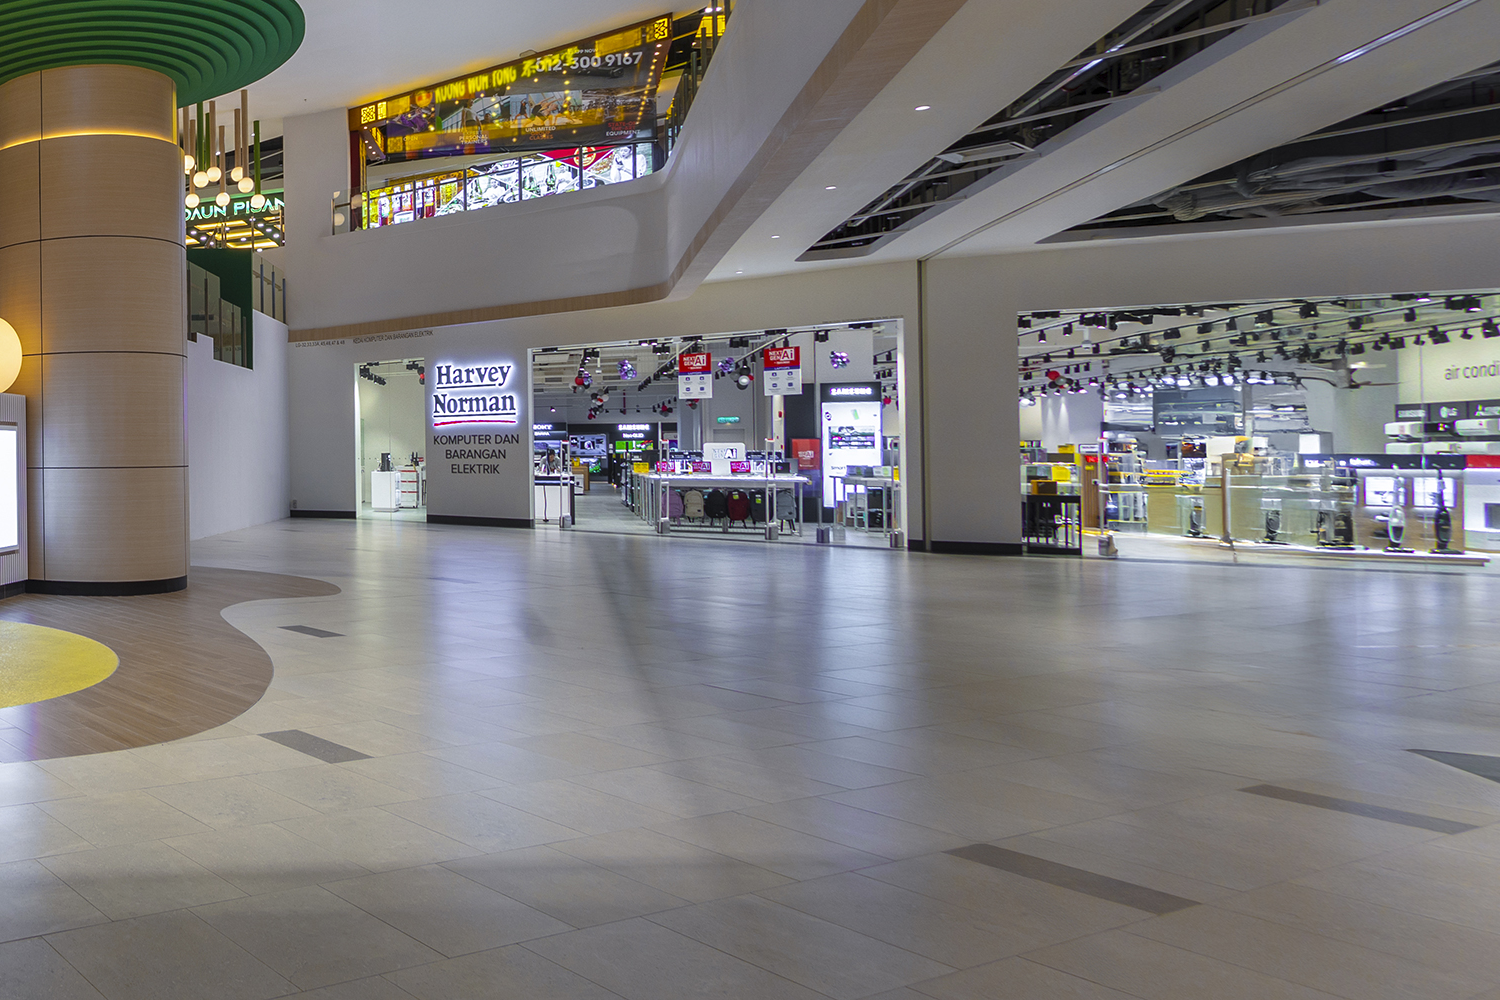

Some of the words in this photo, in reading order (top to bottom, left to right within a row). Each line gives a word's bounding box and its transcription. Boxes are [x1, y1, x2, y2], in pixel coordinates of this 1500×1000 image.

[605, 51, 643, 66] 9167
[525, 125, 556, 133] UNLIMITED
[605, 129, 641, 137] EQUIPMENT
[436, 364, 512, 387] Harvey
[1444, 364, 1461, 380] air
[433, 393, 517, 414] Norman
[433, 435, 492, 446] KOMPUTER
[494, 434, 520, 445] DAN
[445, 449, 507, 460] BARANGAN
[450, 463, 500, 475] ELEKTRIK
